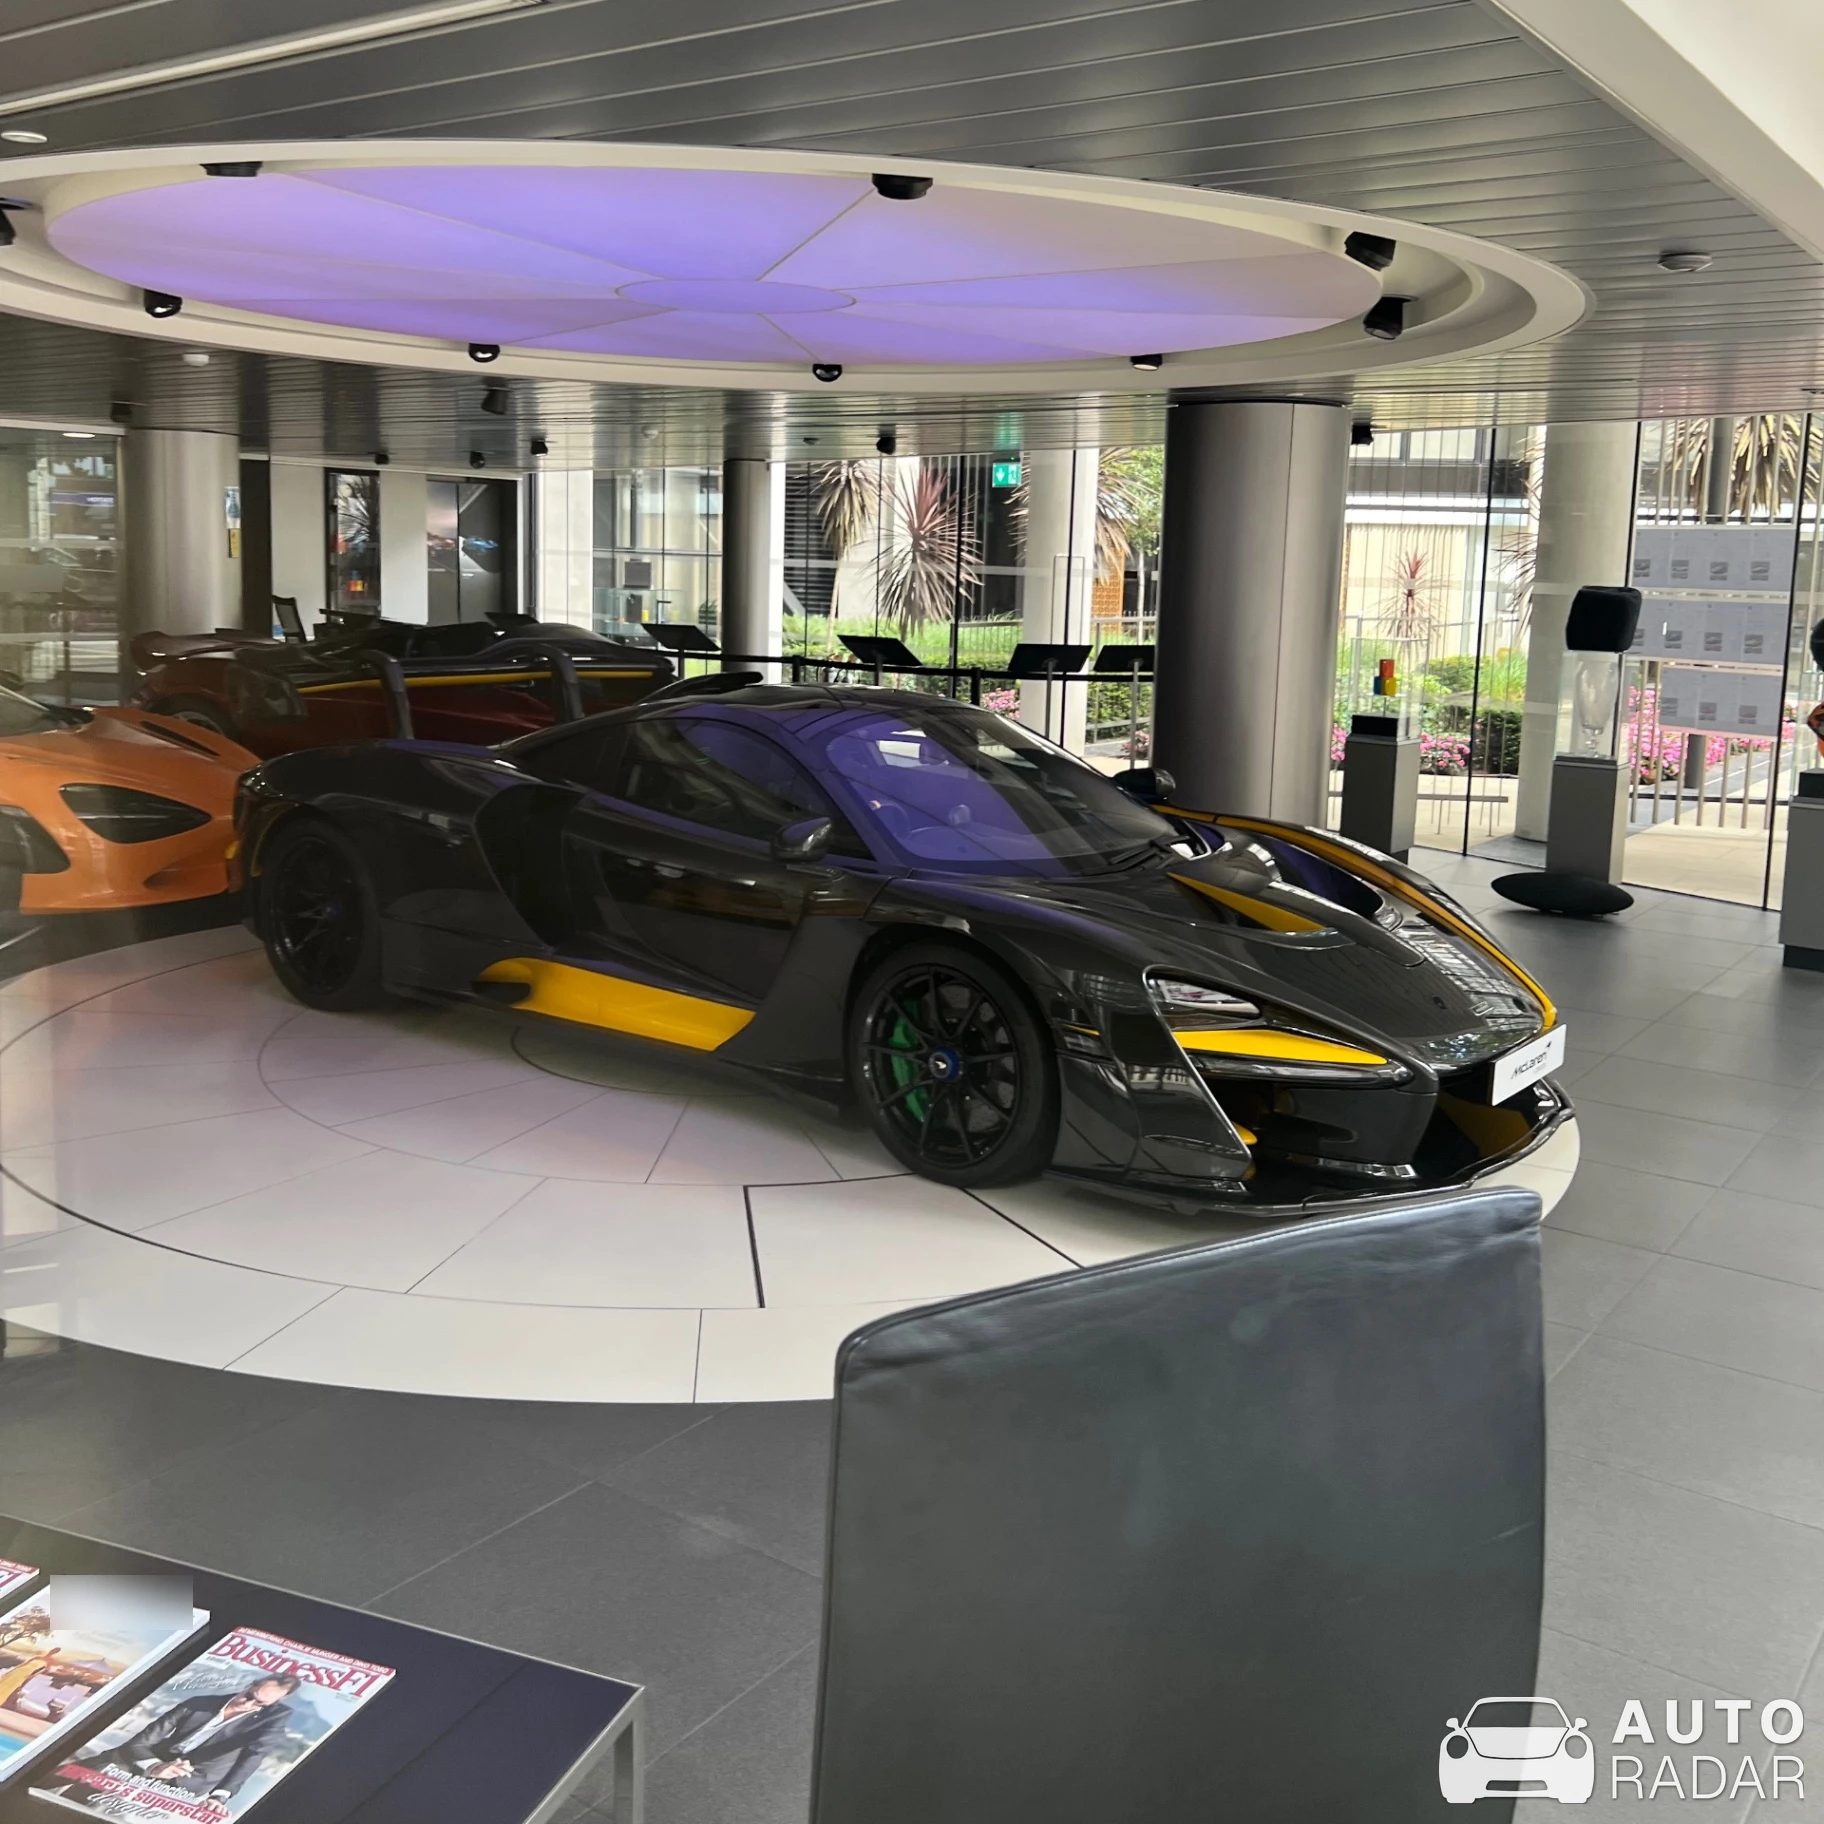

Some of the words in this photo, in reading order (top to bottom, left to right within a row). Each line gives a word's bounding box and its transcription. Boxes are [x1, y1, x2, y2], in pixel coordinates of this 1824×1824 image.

[1510, 1051, 1547, 1079] McLaren
[283, 1639, 312, 1653] CHARLIE
[338, 1656, 354, 1664] AND
[100, 1763, 133, 1782] Form
[129, 1774, 155, 1788] and
[133, 1790, 223, 1824] superstar
